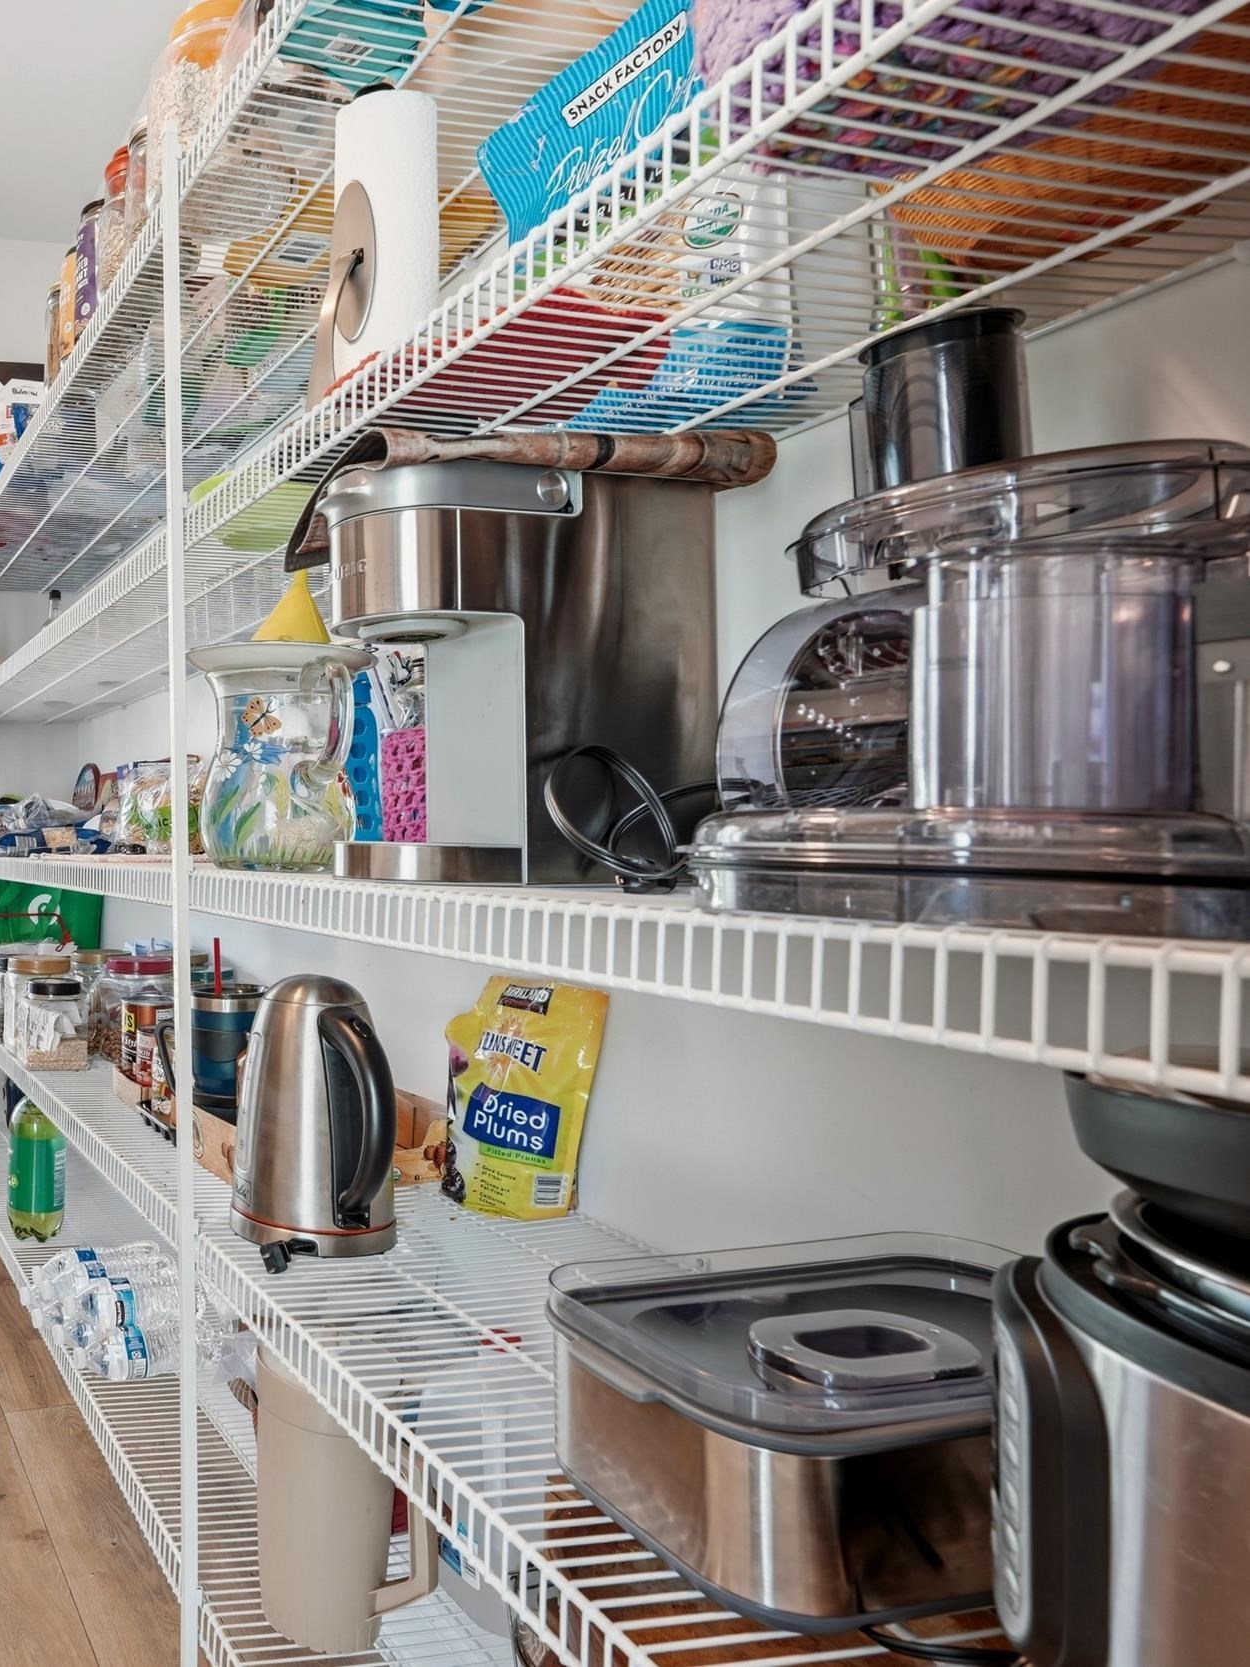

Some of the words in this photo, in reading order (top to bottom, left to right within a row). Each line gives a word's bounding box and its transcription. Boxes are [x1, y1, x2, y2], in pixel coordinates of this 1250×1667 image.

[568, 79, 613, 120] SNACK
[615, 20, 683, 83] FACTORY
[542, 98, 637, 214] Pretzel
[503, 985, 550, 1003] KIRKLAND
[475, 1031, 548, 1073] UNSWEET
[473, 1110, 544, 1151] Plums
[483, 1094, 547, 1130] Dried
[486, 1147, 512, 1158] Pitted
[515, 1151, 547, 1165] Prunes
